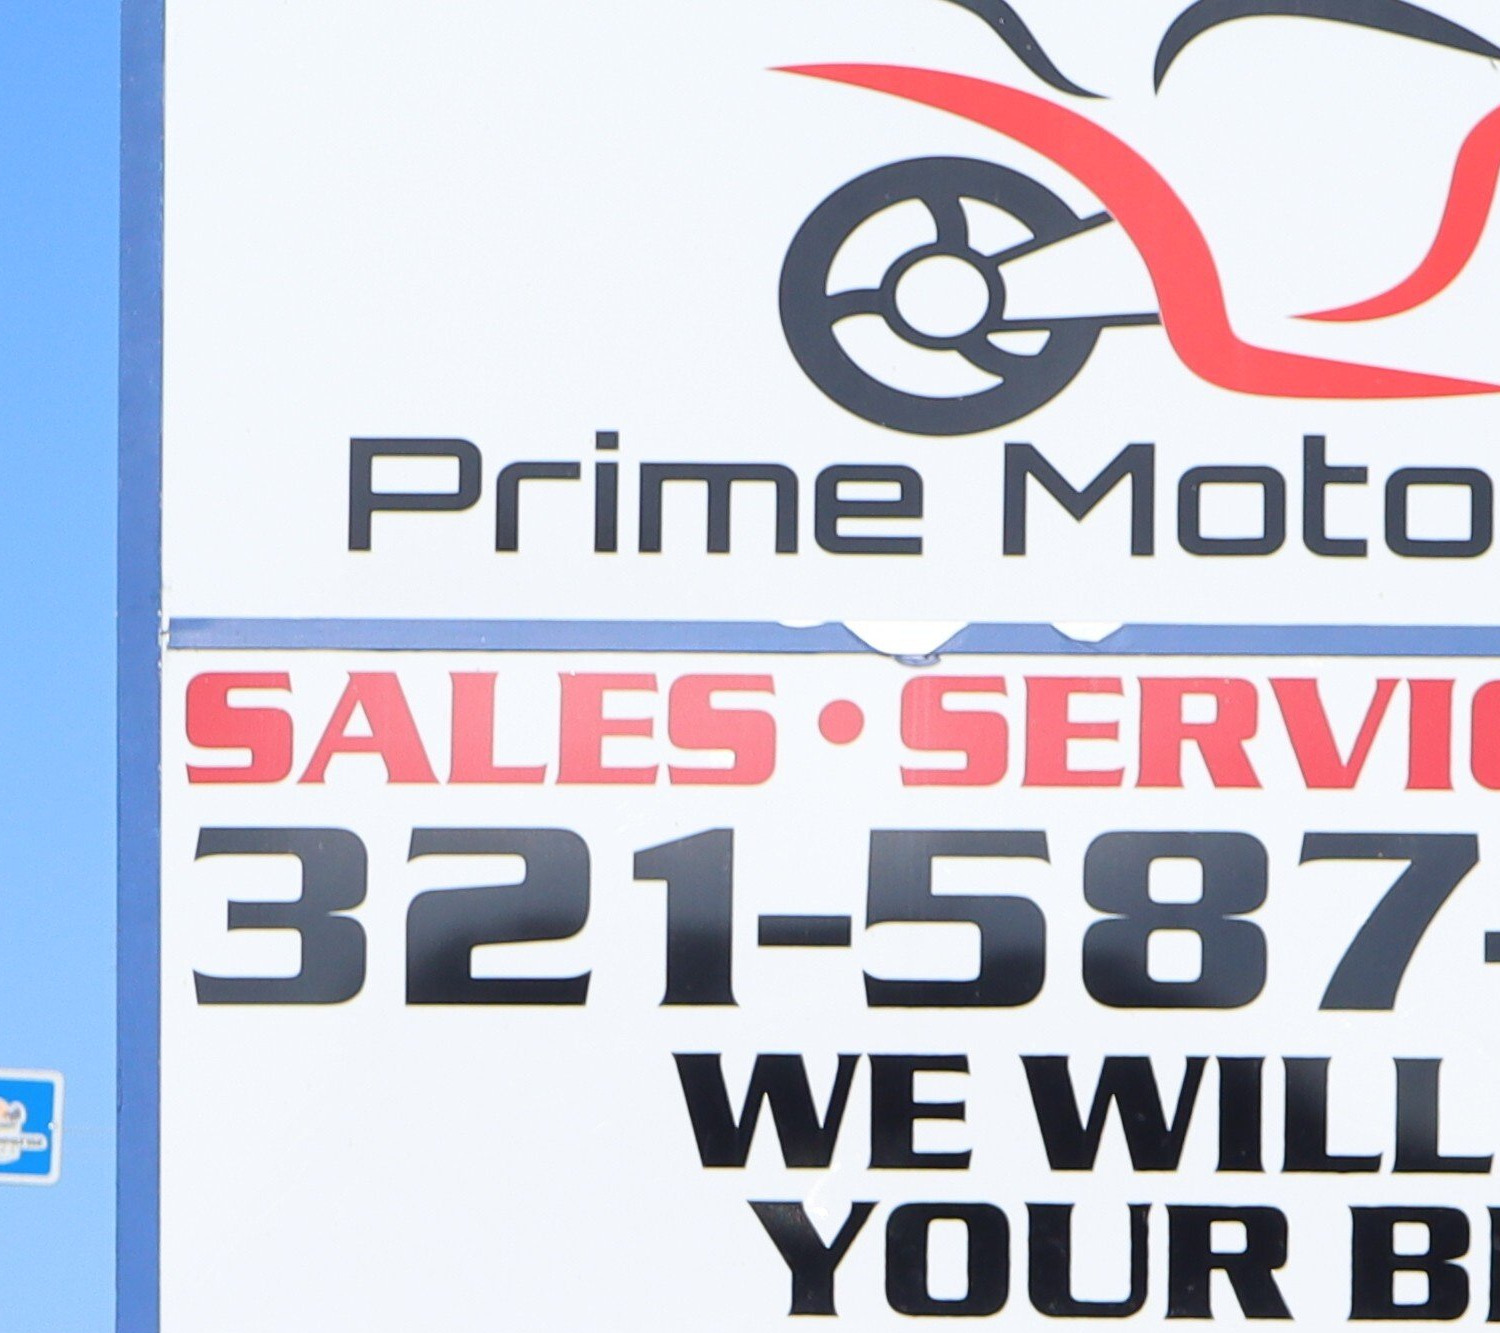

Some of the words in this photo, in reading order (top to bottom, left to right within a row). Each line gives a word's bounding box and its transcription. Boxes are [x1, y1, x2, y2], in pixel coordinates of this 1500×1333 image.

[348, 430, 923, 556] Prime
[186, 672, 775, 785] SALES
[672, 1053, 972, 1170] WE
[1020, 1055, 1493, 1174] WILL
[748, 1200, 1293, 1321] YOUR
